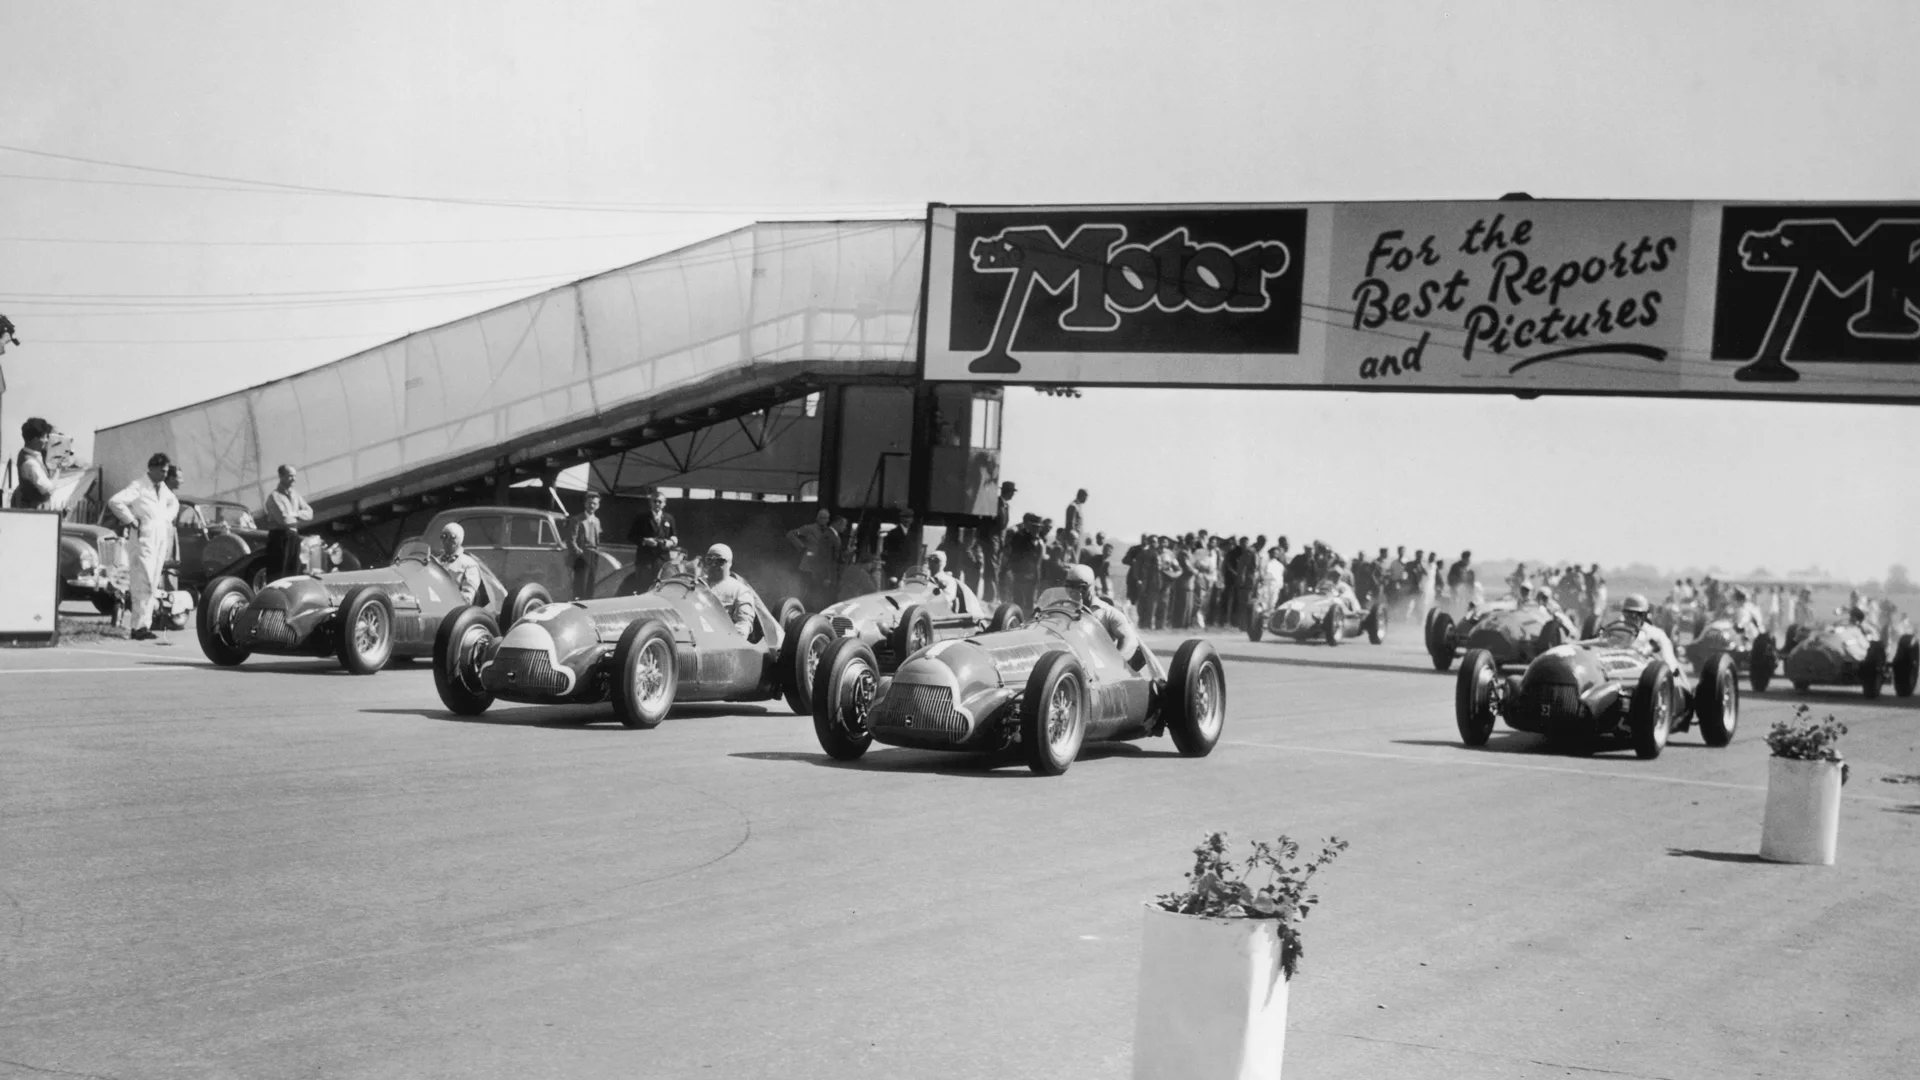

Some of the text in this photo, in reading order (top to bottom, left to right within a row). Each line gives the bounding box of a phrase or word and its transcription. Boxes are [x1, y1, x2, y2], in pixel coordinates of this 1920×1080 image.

[1351, 268, 1471, 332] Best
[1487, 234, 1678, 306] Reports
[1364, 213, 1534, 278] For the
[968, 223, 1291, 374] Motor
[1358, 289, 1664, 380] and Pictures
